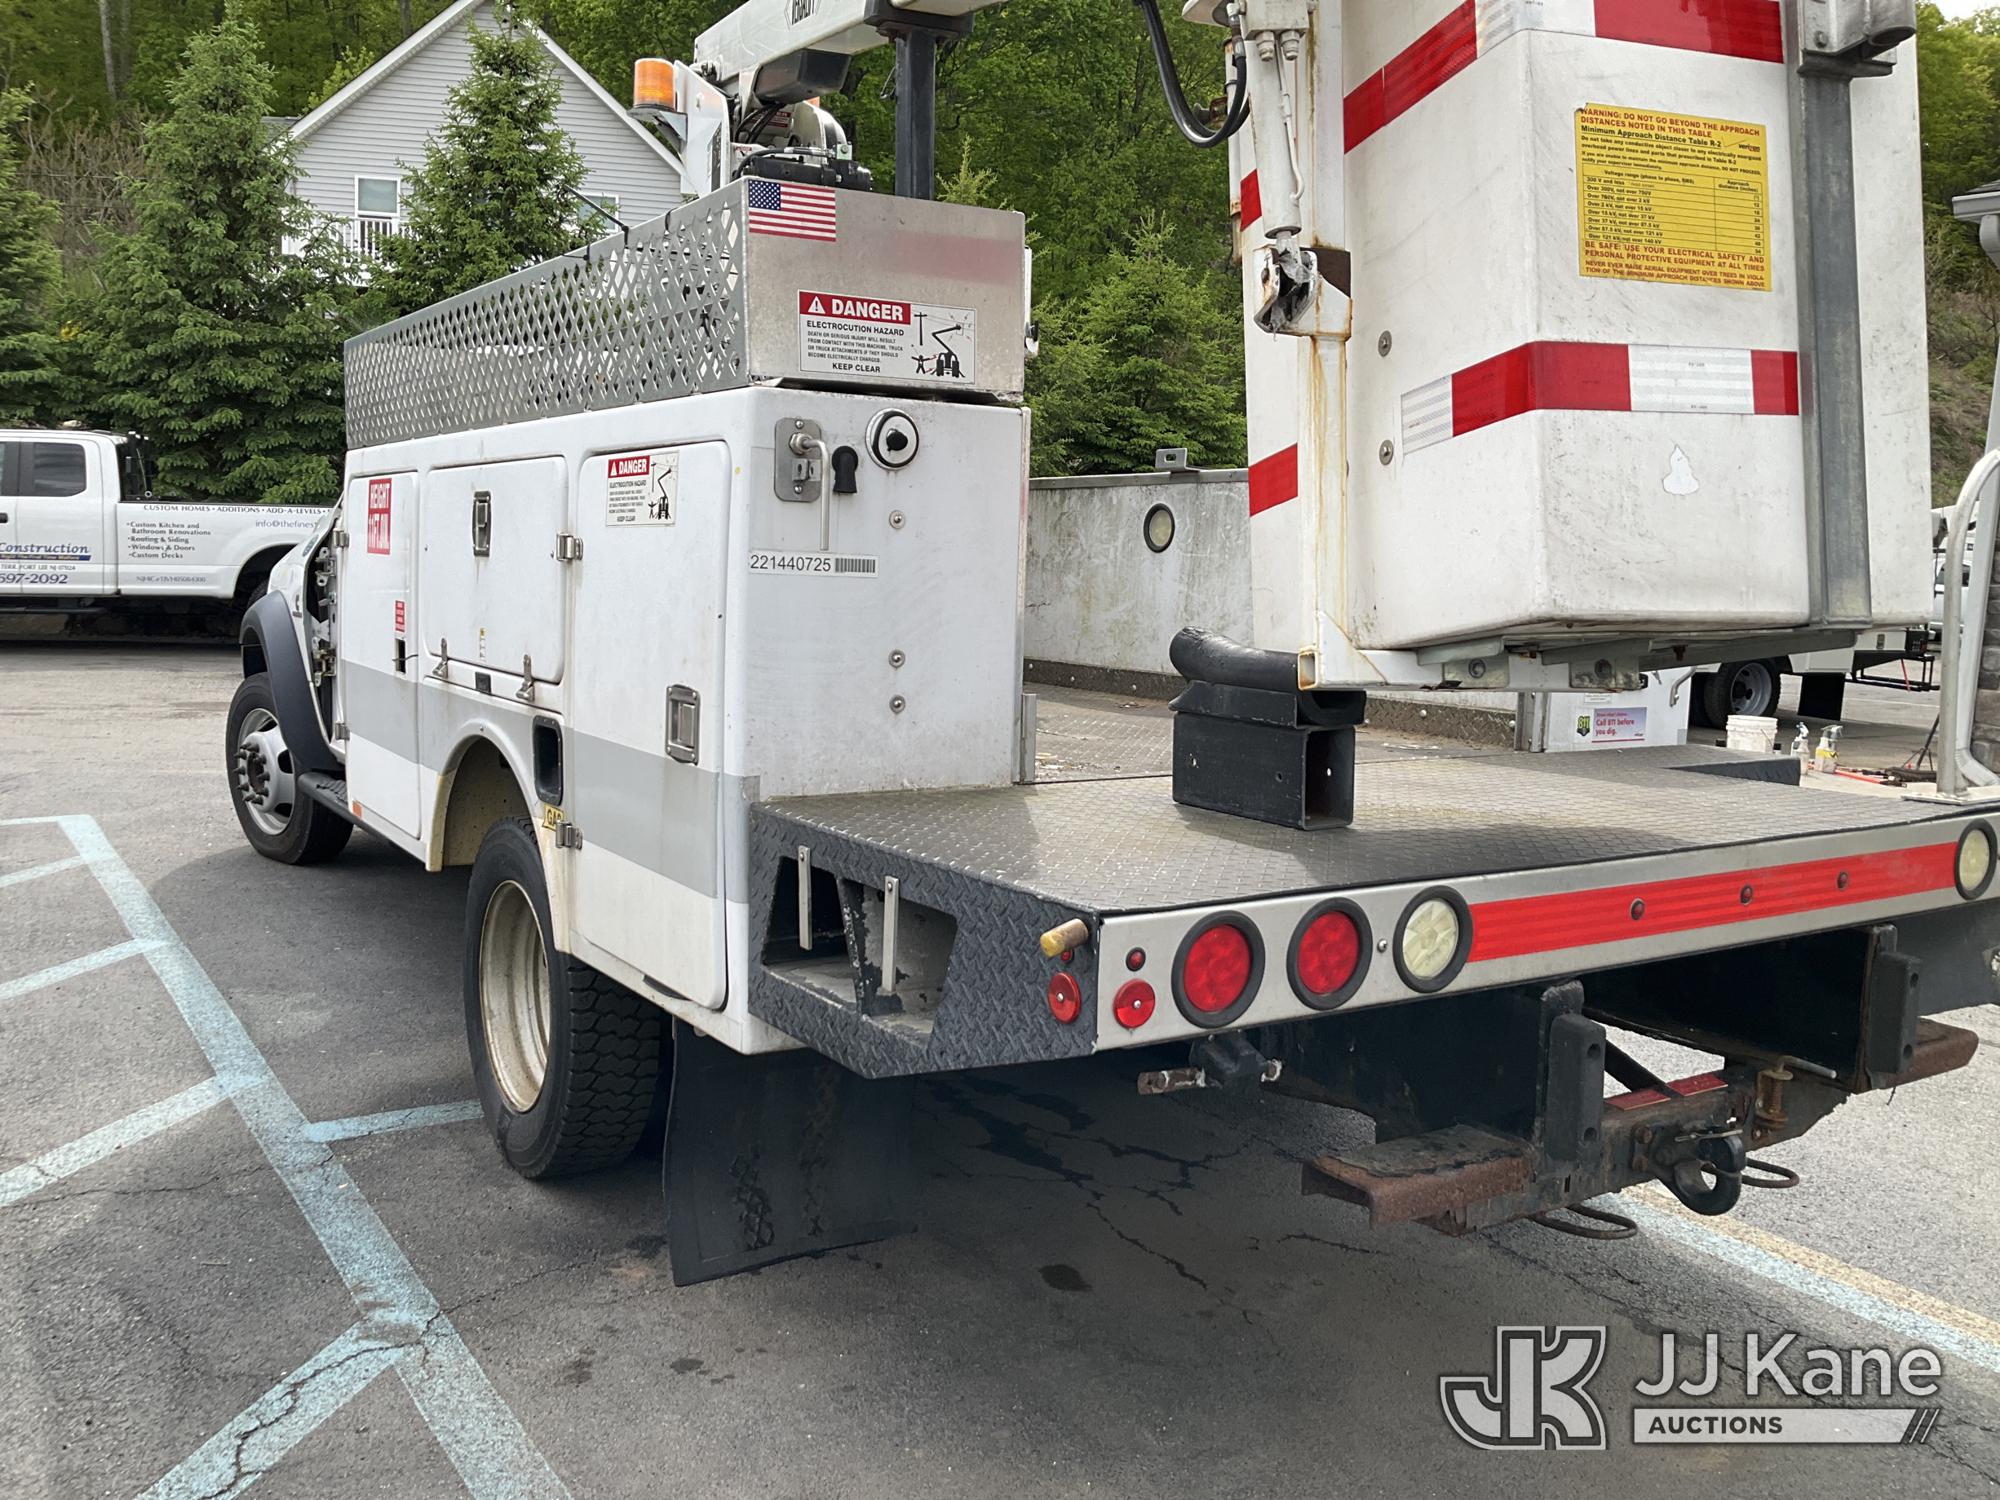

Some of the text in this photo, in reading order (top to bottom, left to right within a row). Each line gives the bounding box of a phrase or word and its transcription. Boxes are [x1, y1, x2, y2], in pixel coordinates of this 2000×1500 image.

[1580, 116, 1711, 138] DISTANCES NOTED IN THIS TABLE
[1626, 114, 1639, 122] DO
[1640, 116, 1656, 124] NOT
[1659, 118, 1672, 126] GO
[1672, 119, 1704, 130] BEYOND
[1706, 123, 1720, 132] THE
[1722, 125, 1760, 136] APPROACH
[1581, 125, 1721, 147] Minimum Approach Distance Table R-2
[1599, 242, 1622, 251] SAFE:
[1625, 244, 1641, 252] USE
[1645, 246, 1667, 255] YOUR
[1670, 248, 1715, 259] ELECTRICAL
[1719, 252, 1746, 262] SAFETY
[1749, 255, 1764, 263] AND
[1584, 250, 1625, 260] PERSONAL
[1627, 253, 1672, 264] PROTECTIVE
[1674, 257, 1716, 267] EQUIPMENT
[1729, 262, 1741, 270] ALL
[1744, 263, 1764, 272] TIMES
[1585, 260, 1605, 268] NEVER
[1664, 267, 1698, 275] EQUIPMENT
[1654, 273, 1686, 281] APPROACH
[1722, 278, 1743, 286] SHOWN
[832, 298, 904, 321] DANGER
[806, 320, 904, 336] ELECTROCUTION HAZARD
[826, 353, 857, 361] ELECTRICALLY
[831, 347, 863, 355] ATTACHMENTS
[832, 363, 880, 373] KEEP CLEAR
[618, 458, 647, 475] DANGER
[0, 542, 89, 553] Construction
[130, 536, 159, 544] Roofing
[167, 536, 190, 544] Siding
[750, 555, 831, 572] 221440725
[1596, 718, 1607, 727] Call
[1617, 718, 1635, 726] before
